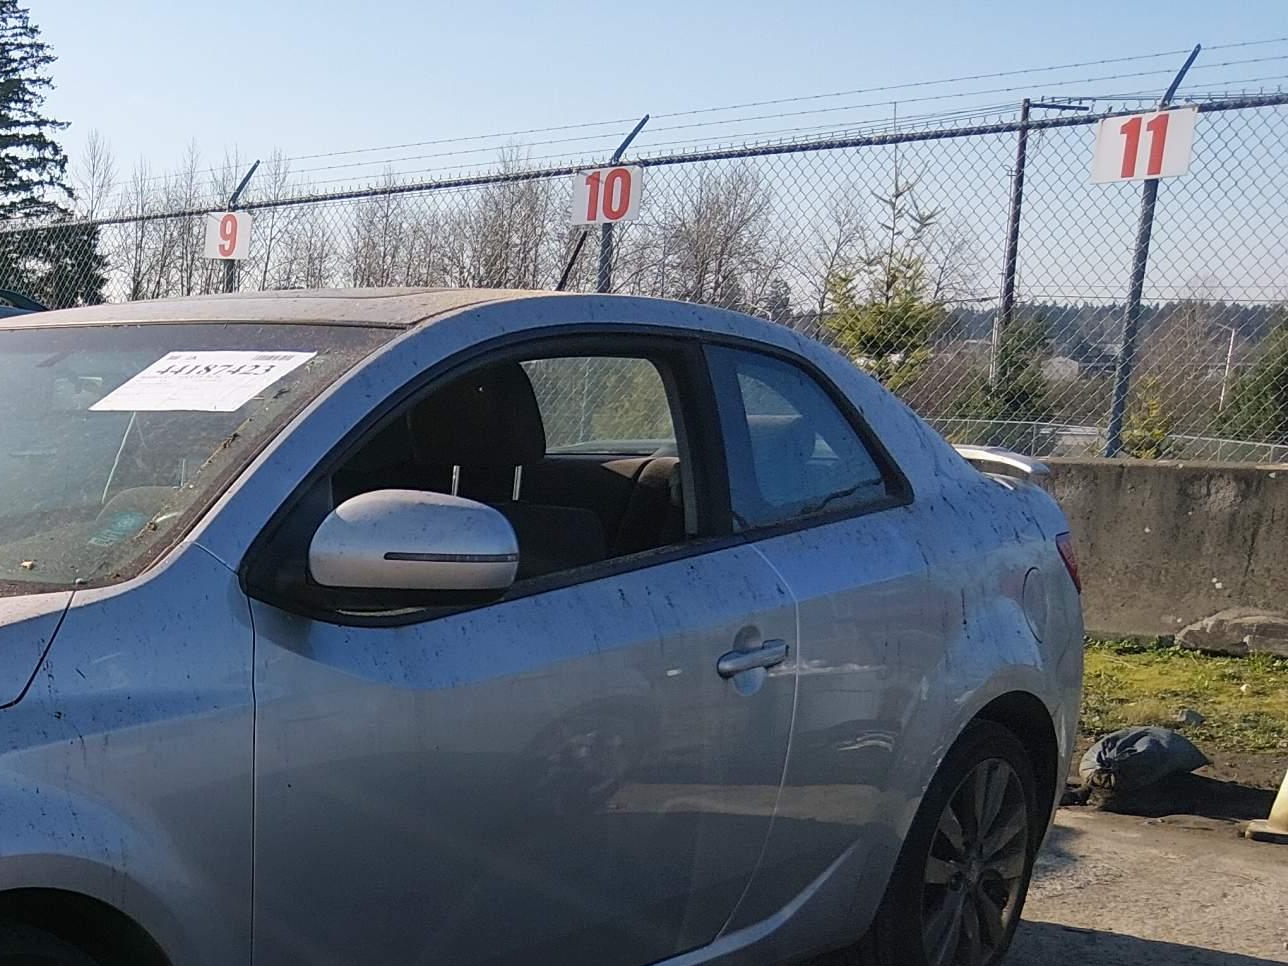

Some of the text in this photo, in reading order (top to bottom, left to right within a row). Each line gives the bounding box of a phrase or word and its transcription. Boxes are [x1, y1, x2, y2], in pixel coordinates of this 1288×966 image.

[1119, 113, 1170, 179] 11
[585, 167, 632, 222] 10
[218, 213, 238, 258] 9
[156, 364, 277, 376] 44187423
